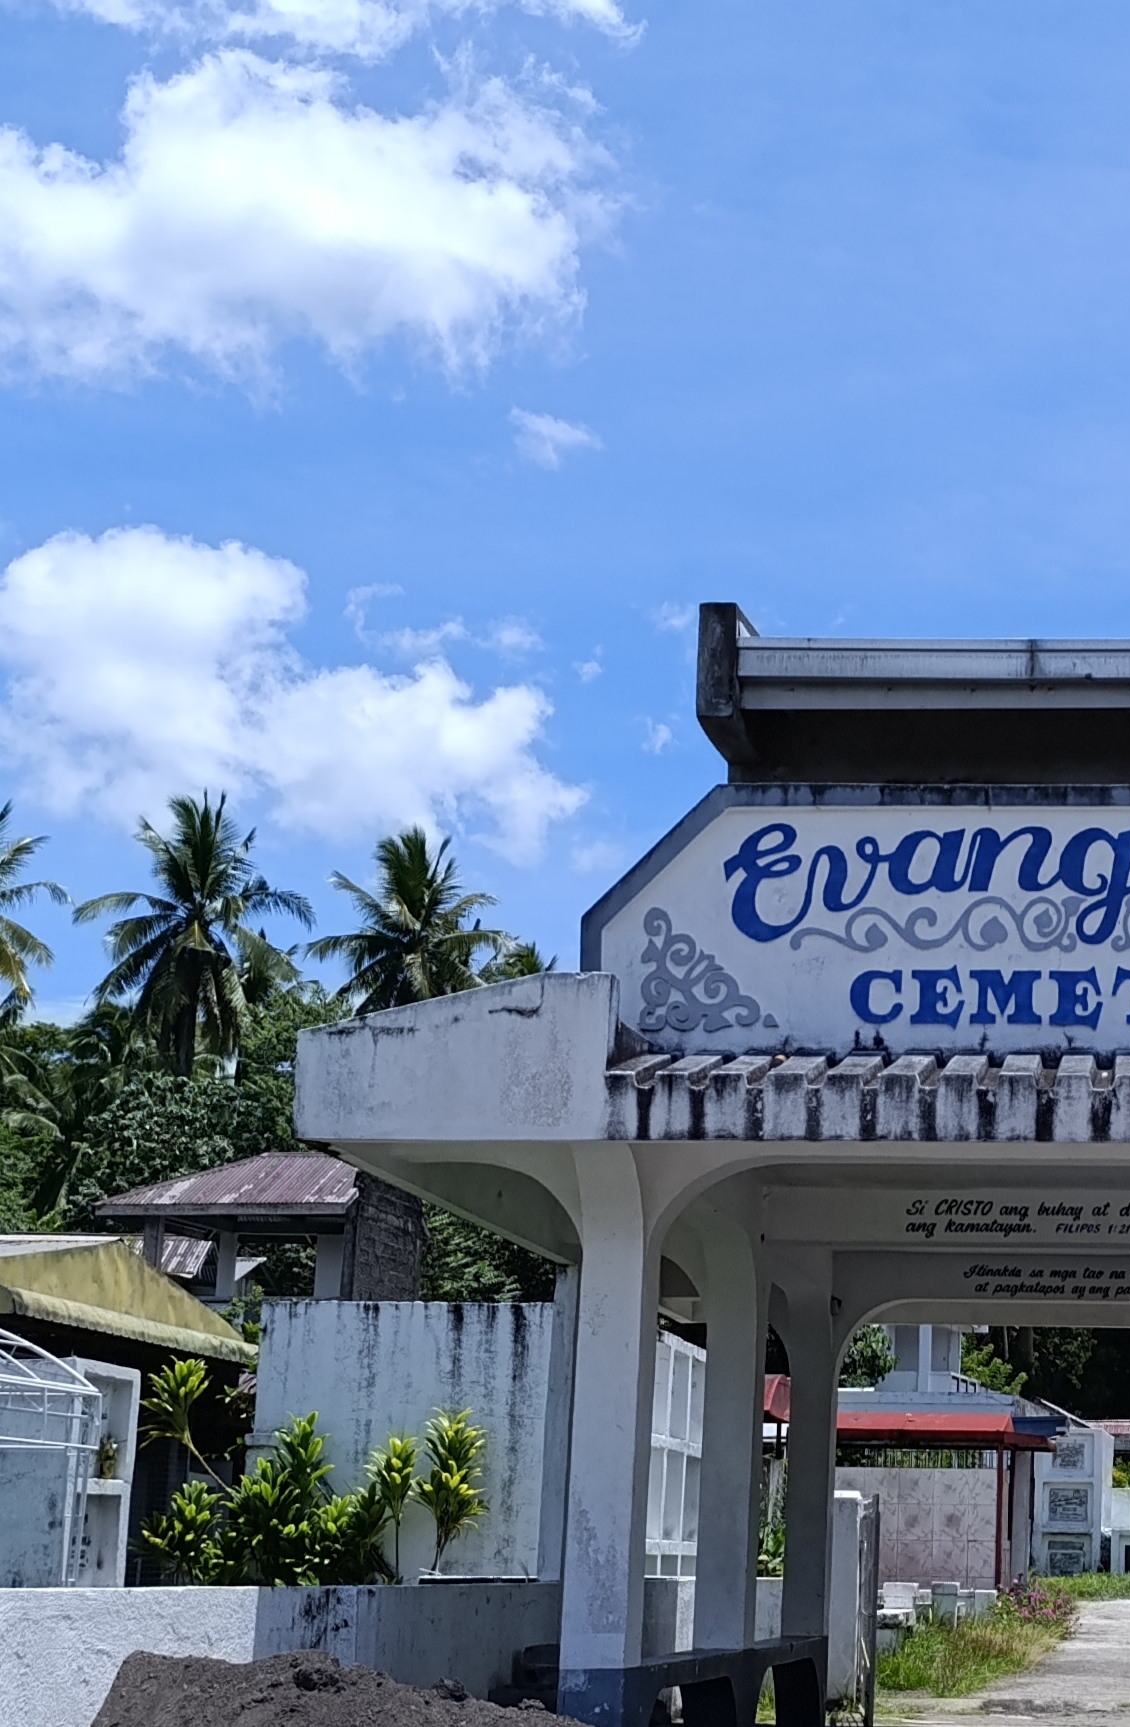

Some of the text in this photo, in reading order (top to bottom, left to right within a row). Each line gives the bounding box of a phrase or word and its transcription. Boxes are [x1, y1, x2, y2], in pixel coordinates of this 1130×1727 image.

[906, 1199, 929, 1216] Si
[934, 1198, 994, 1216] CRISTO
[999, 1203, 1030, 1221] ang
[1037, 1201, 1084, 1221] buhay
[1091, 1202, 1111, 1217] at
[905, 1222, 937, 1239] ang
[944, 1218, 1037, 1238] kamatayan.
[1055, 1222, 1101, 1234] FILIPOS
[963, 1263, 1022, 1279] Itinakda
[1028, 1268, 1044, 1278] sa
[1049, 1268, 1077, 1282] mga
[1082, 1266, 1105, 1280] tao
[1108, 1269, 1126, 1280] na
[974, 1281, 991, 1293] at
[992, 1281, 1066, 1298] pagkatapos
[1071, 1285, 1086, 1299] ay
[1088, 1285, 1111, 1299] ang
